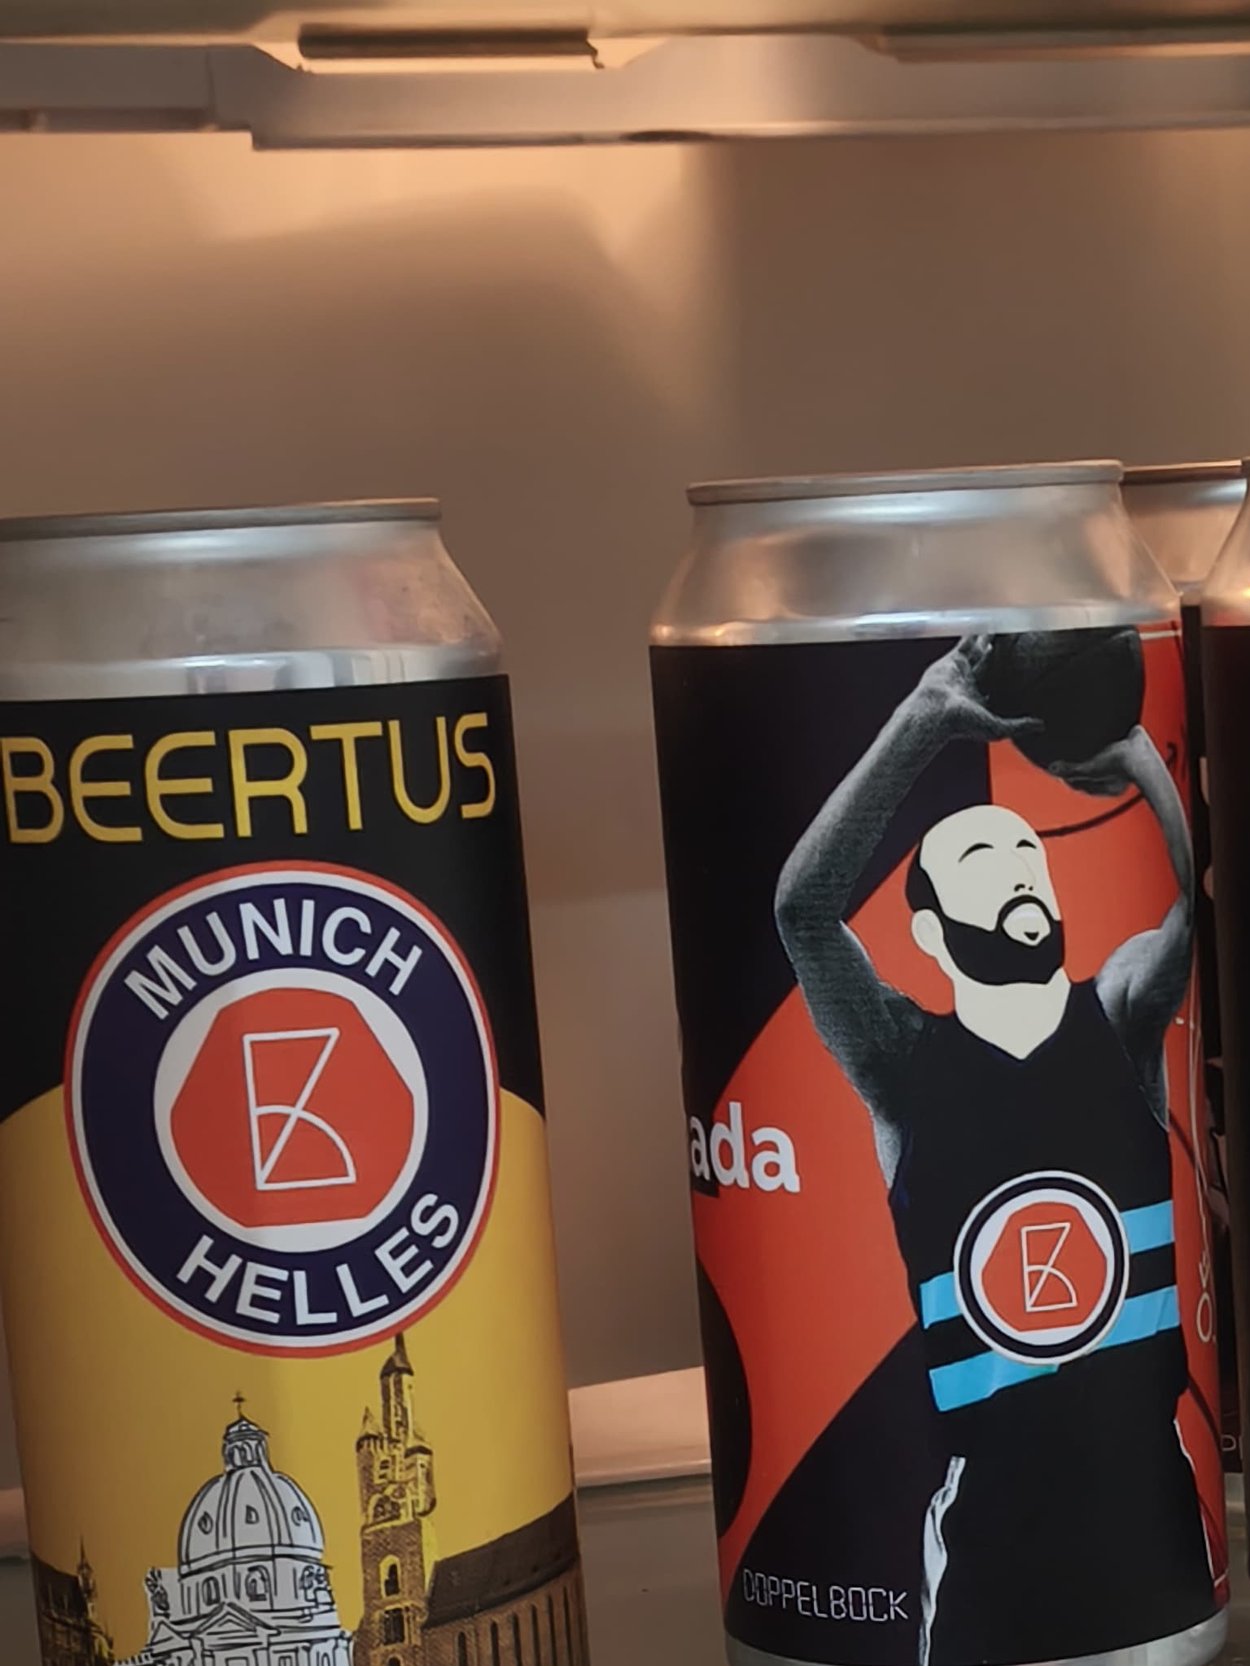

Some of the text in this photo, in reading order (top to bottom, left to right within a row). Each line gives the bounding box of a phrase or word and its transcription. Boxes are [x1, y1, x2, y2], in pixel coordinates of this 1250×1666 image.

[0, 712, 497, 844] BEERTUS
[124, 897, 423, 1020] MUNICH
[175, 1192, 461, 1326] HELLES
[743, 1568, 909, 1622] DOPPELBOCK
